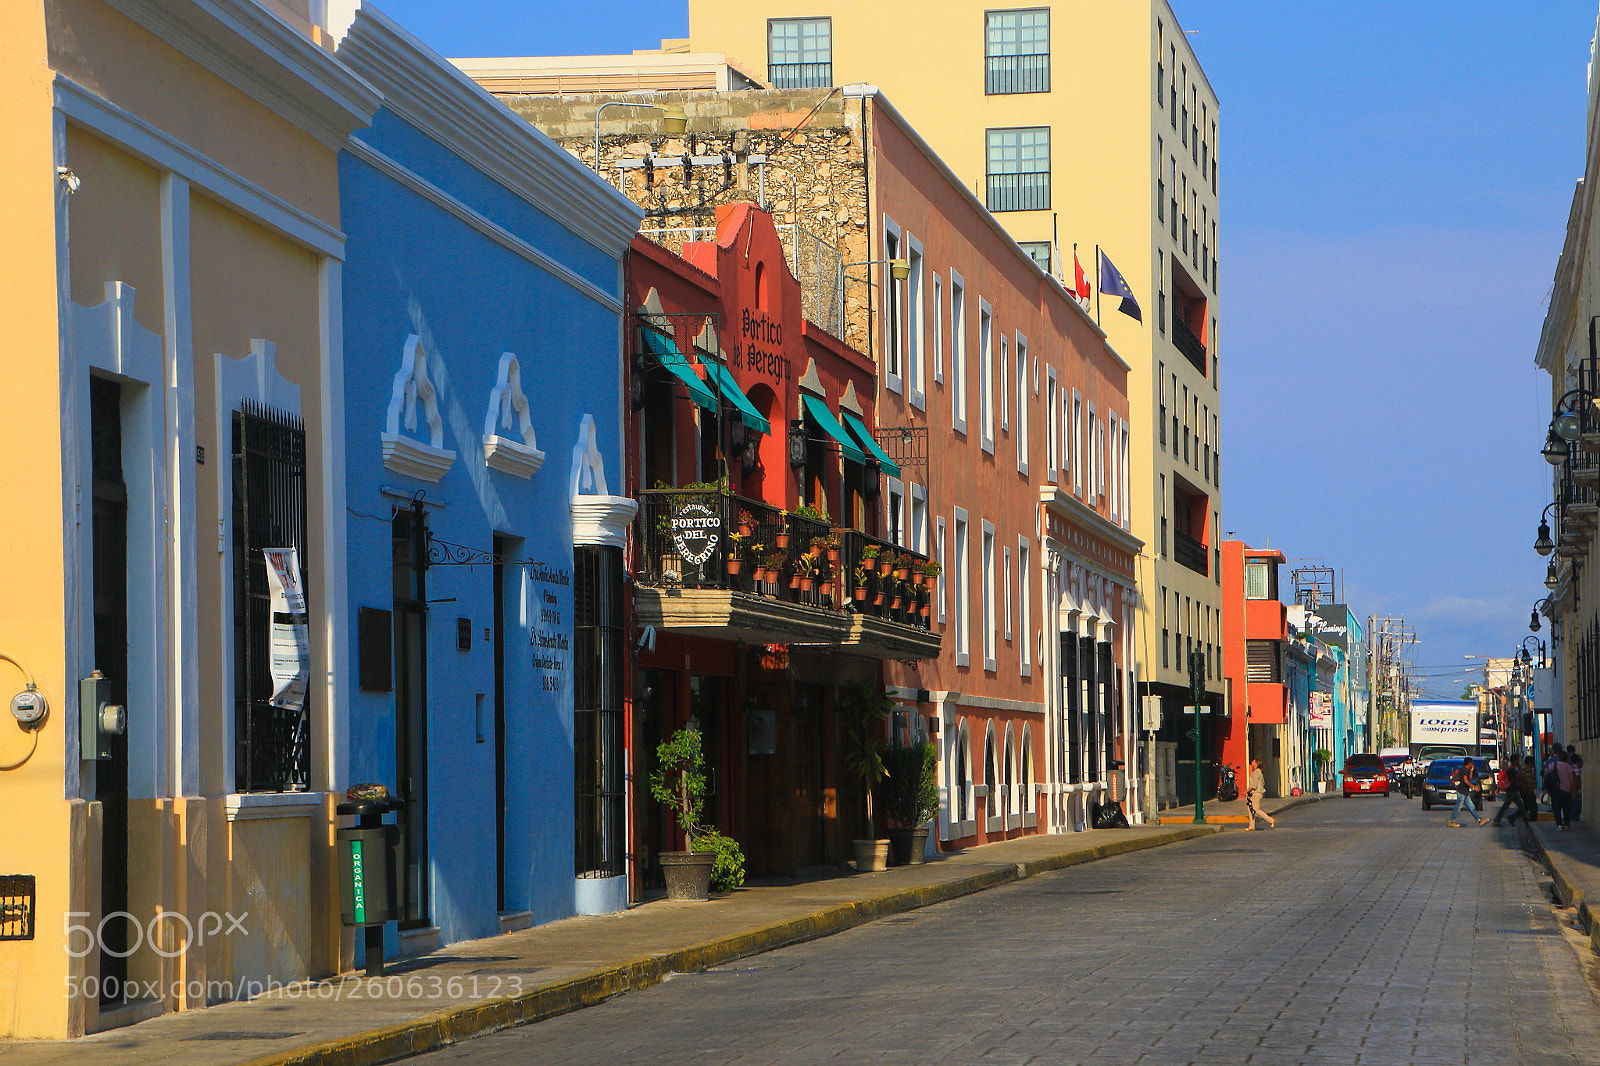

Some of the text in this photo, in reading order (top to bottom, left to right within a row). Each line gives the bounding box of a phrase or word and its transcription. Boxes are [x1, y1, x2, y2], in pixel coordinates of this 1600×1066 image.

[671, 517, 721, 529] PORTICO
[683, 530, 708, 540] DEL
[673, 534, 719, 565] PEREGRINO
[1420, 718, 1469, 726] LOGIS
[352, 853, 363, 909] ORGANICA
